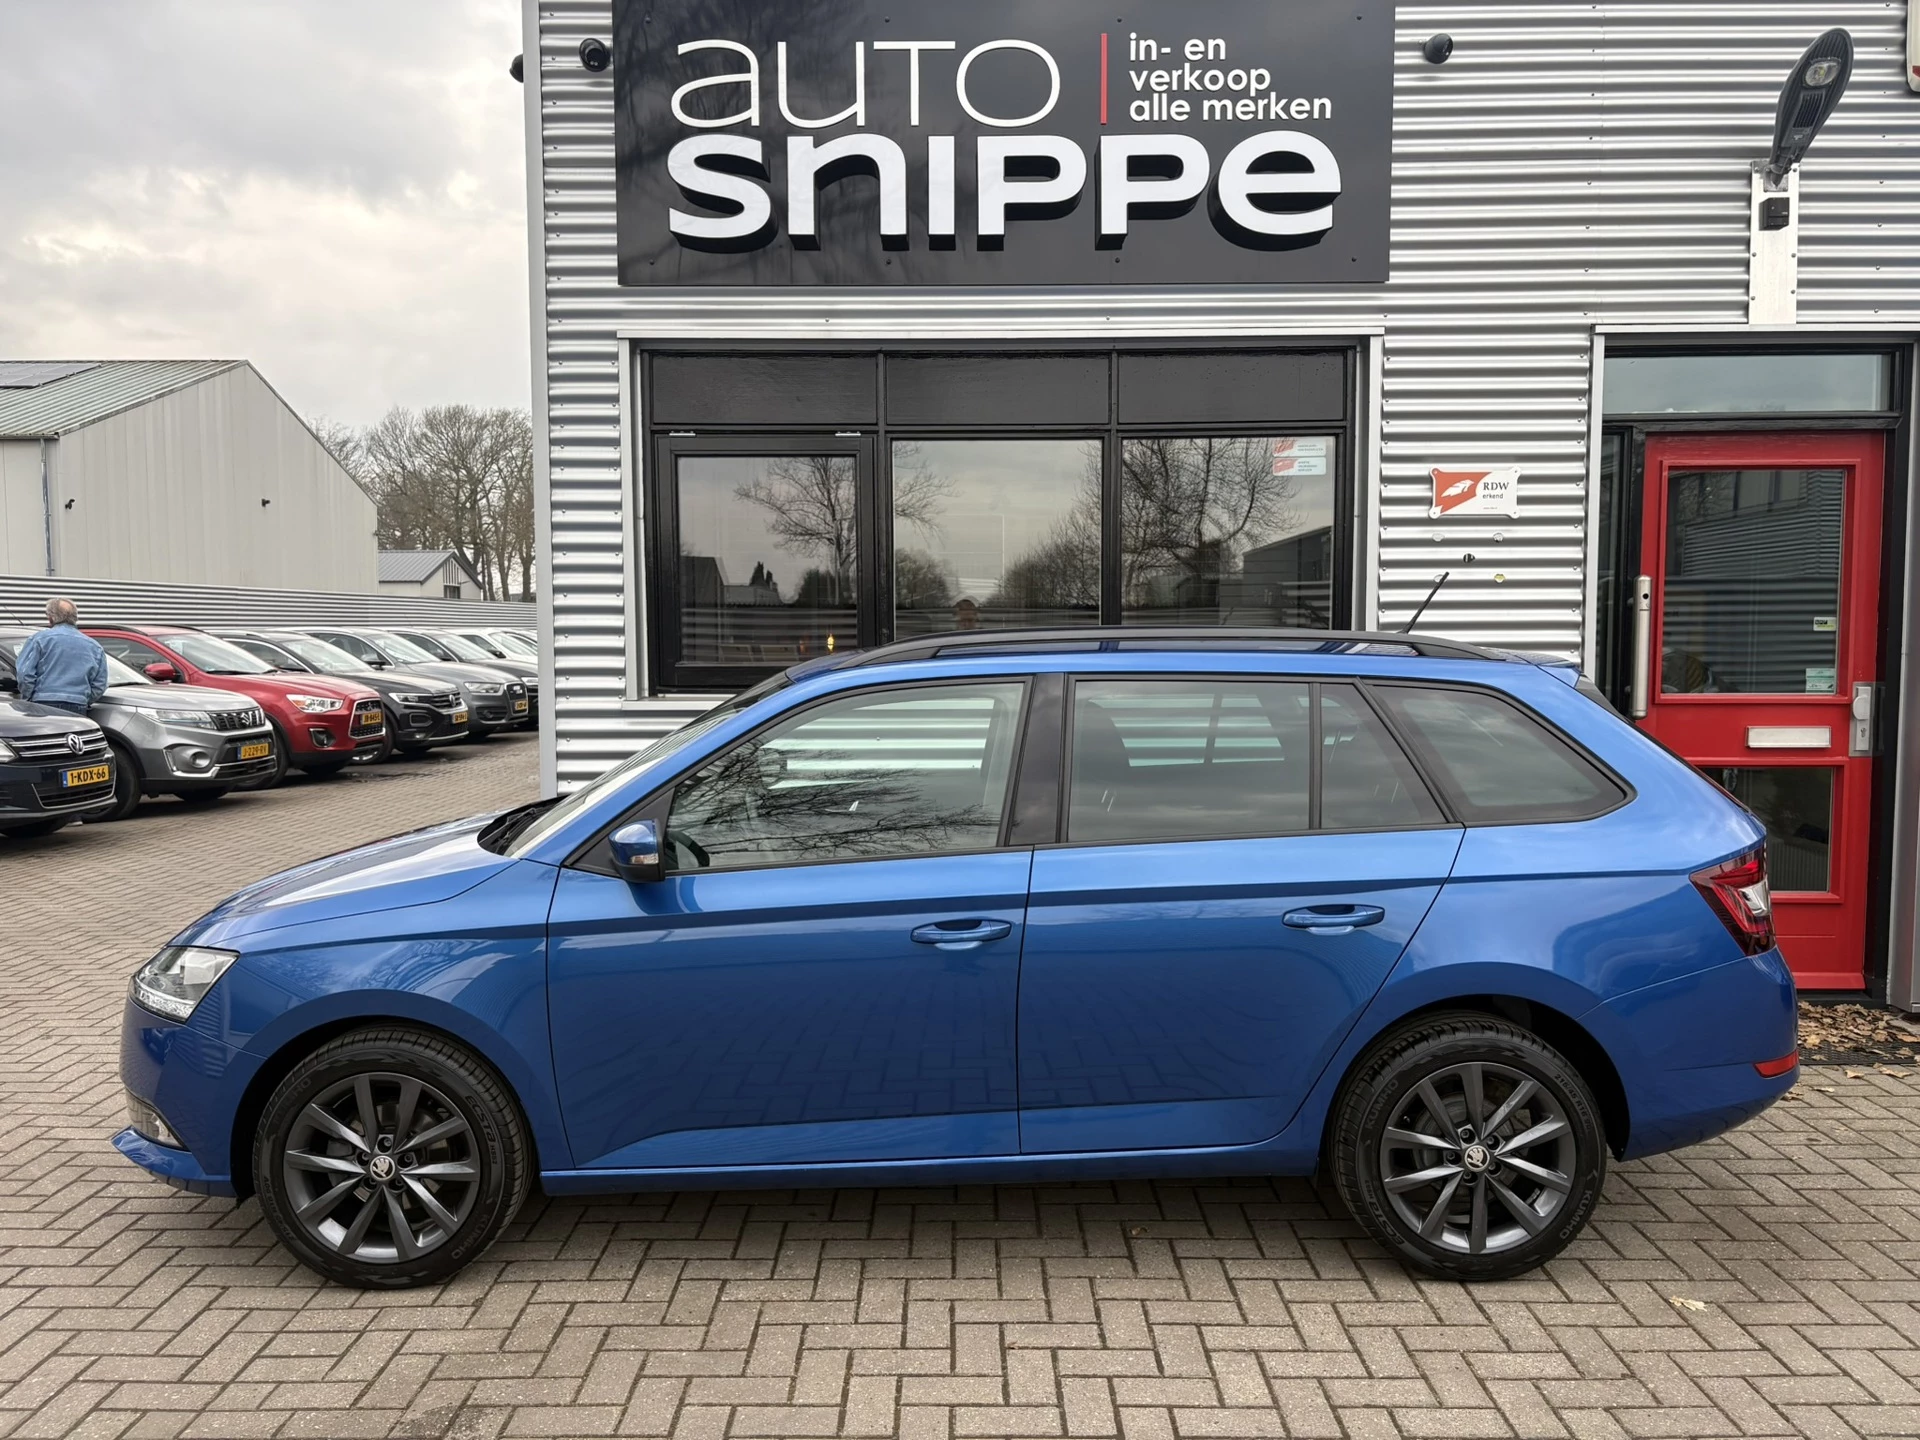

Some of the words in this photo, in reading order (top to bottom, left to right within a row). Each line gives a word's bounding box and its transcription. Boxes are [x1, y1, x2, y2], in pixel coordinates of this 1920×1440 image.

[1129, 32, 1172, 61] in-
[1184, 38, 1226, 61] en
[1129, 62, 1272, 97] verkoop
[1129, 92, 1191, 122] alle
[1202, 91, 1332, 121] merken
[1482, 481, 1510, 491] RDW
[69, 767, 107, 784] 1-KDX-66
[1559, 1189, 1593, 1240] KUMHO
